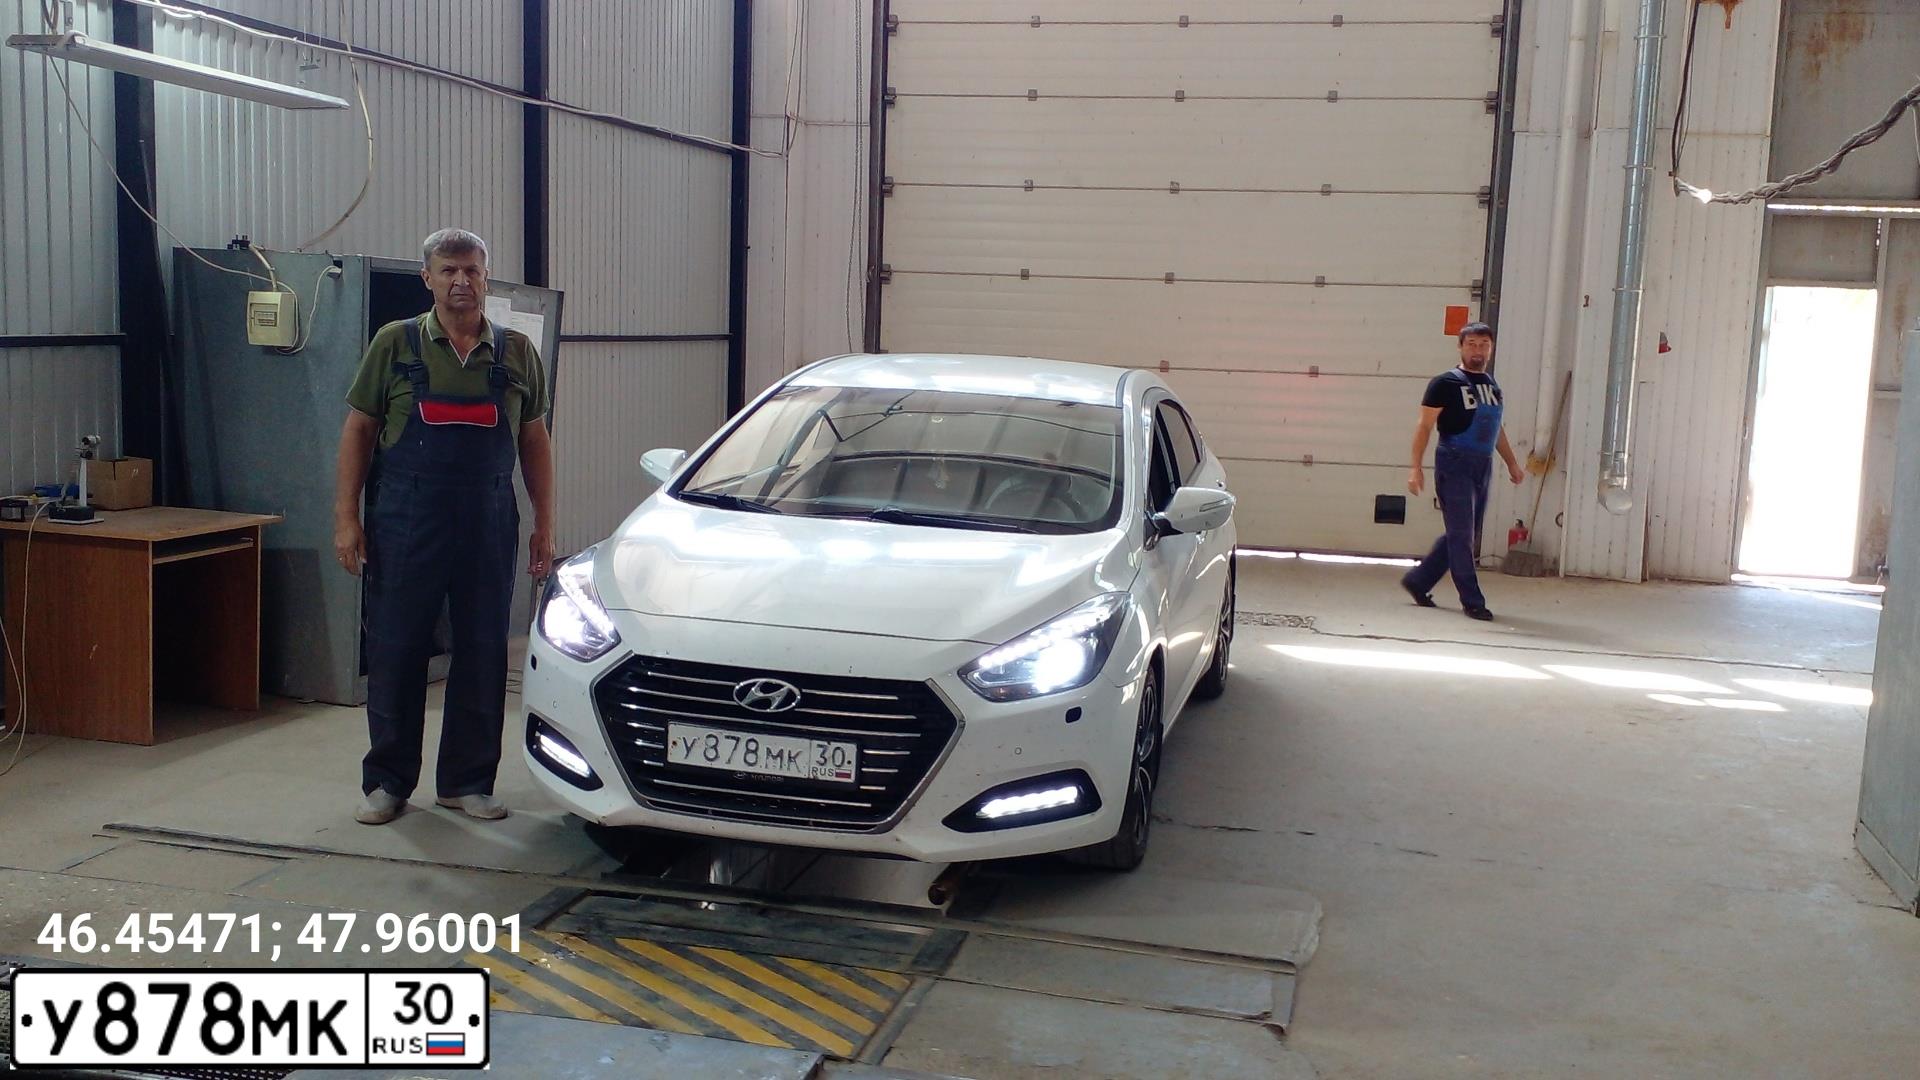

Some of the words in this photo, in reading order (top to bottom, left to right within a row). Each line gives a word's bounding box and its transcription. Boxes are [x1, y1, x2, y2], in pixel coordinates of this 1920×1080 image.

[682, 733, 803, 773] У878МК
[816, 743, 846, 768] 30
[811, 766, 835, 778] RUS
